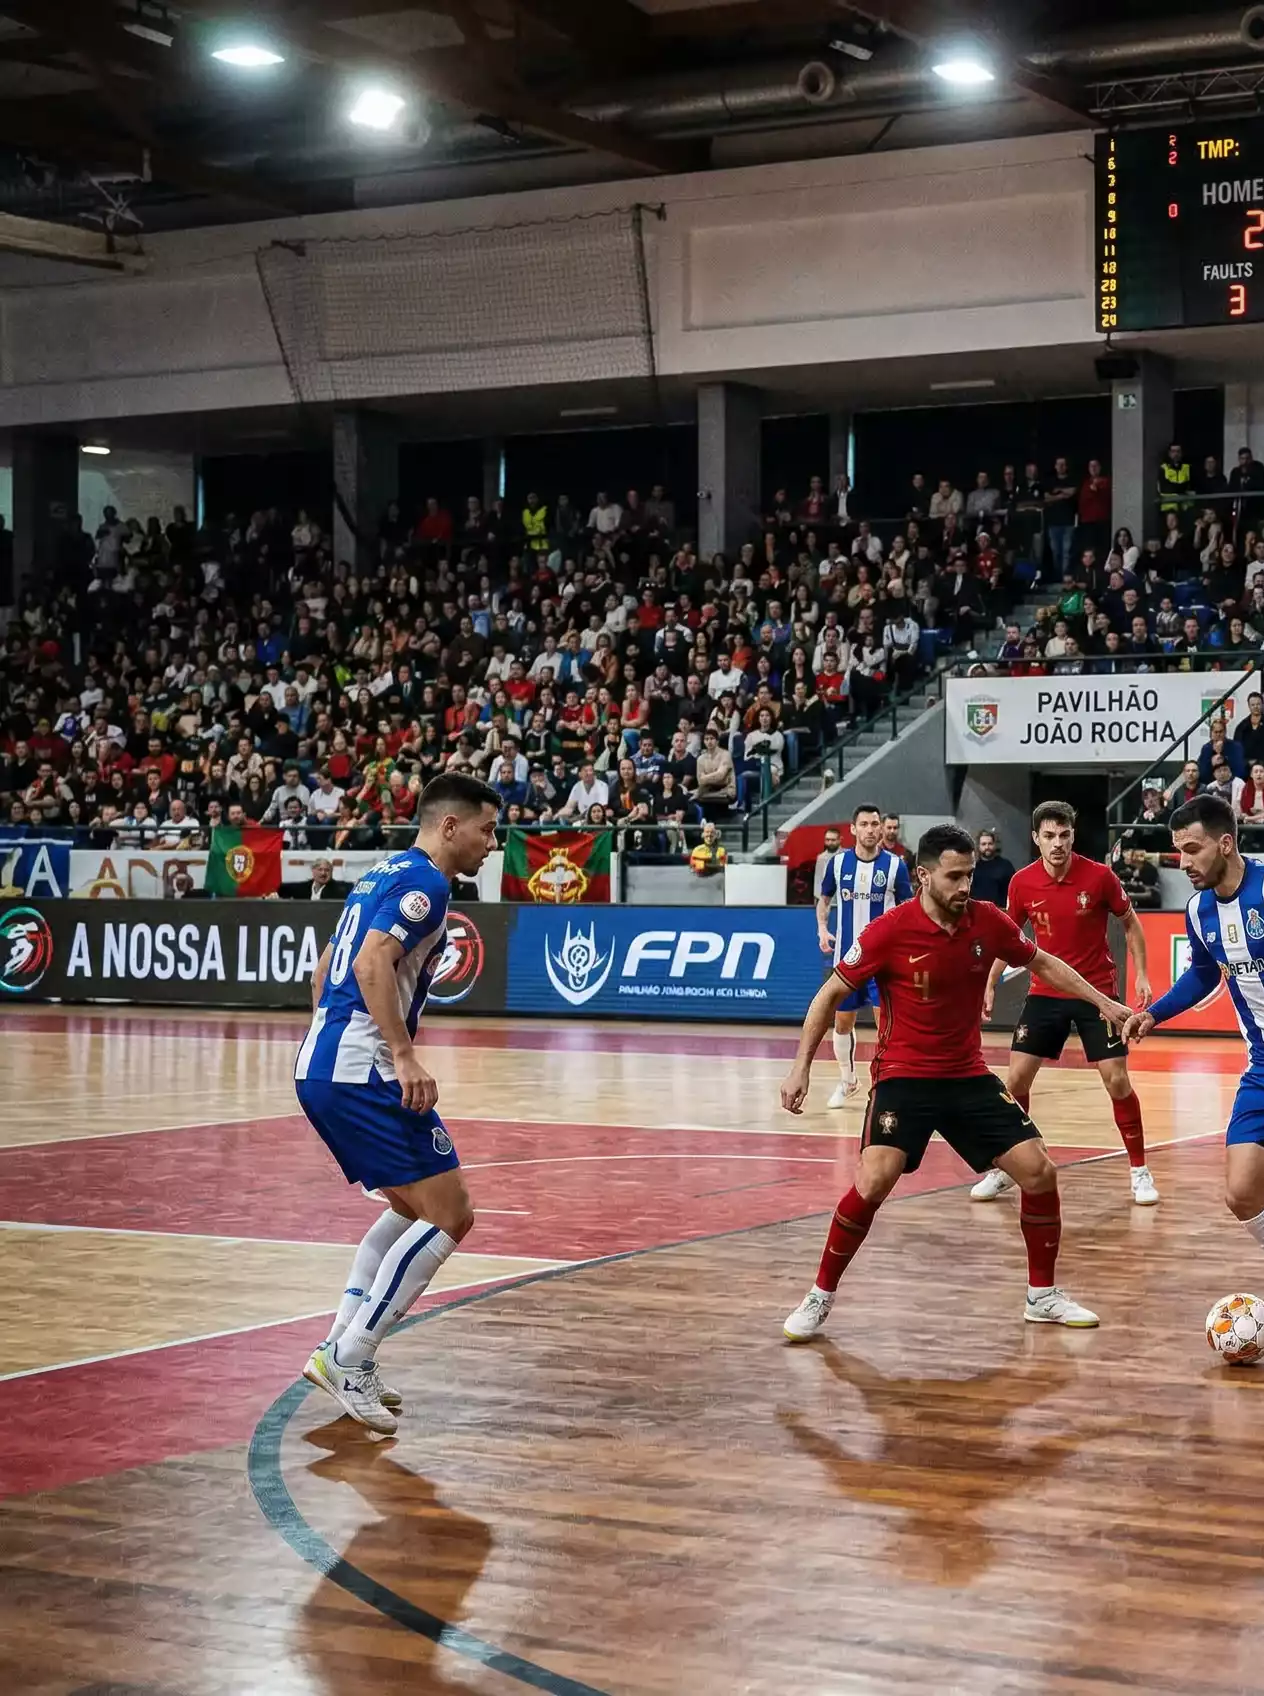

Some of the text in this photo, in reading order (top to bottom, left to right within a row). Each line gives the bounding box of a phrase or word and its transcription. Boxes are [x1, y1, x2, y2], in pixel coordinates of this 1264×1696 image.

[1197, 138, 1239, 159] TMP:
[1203, 178, 1264, 206] HOME
[1203, 261, 1254, 280] FAULTS
[1229, 284, 1246, 315] 3
[1037, 684, 1158, 713] PAVILHÃO
[1020, 717, 1176, 745] JOÃO ROCHA
[67, 922, 319, 982] A NOSSA LIGA
